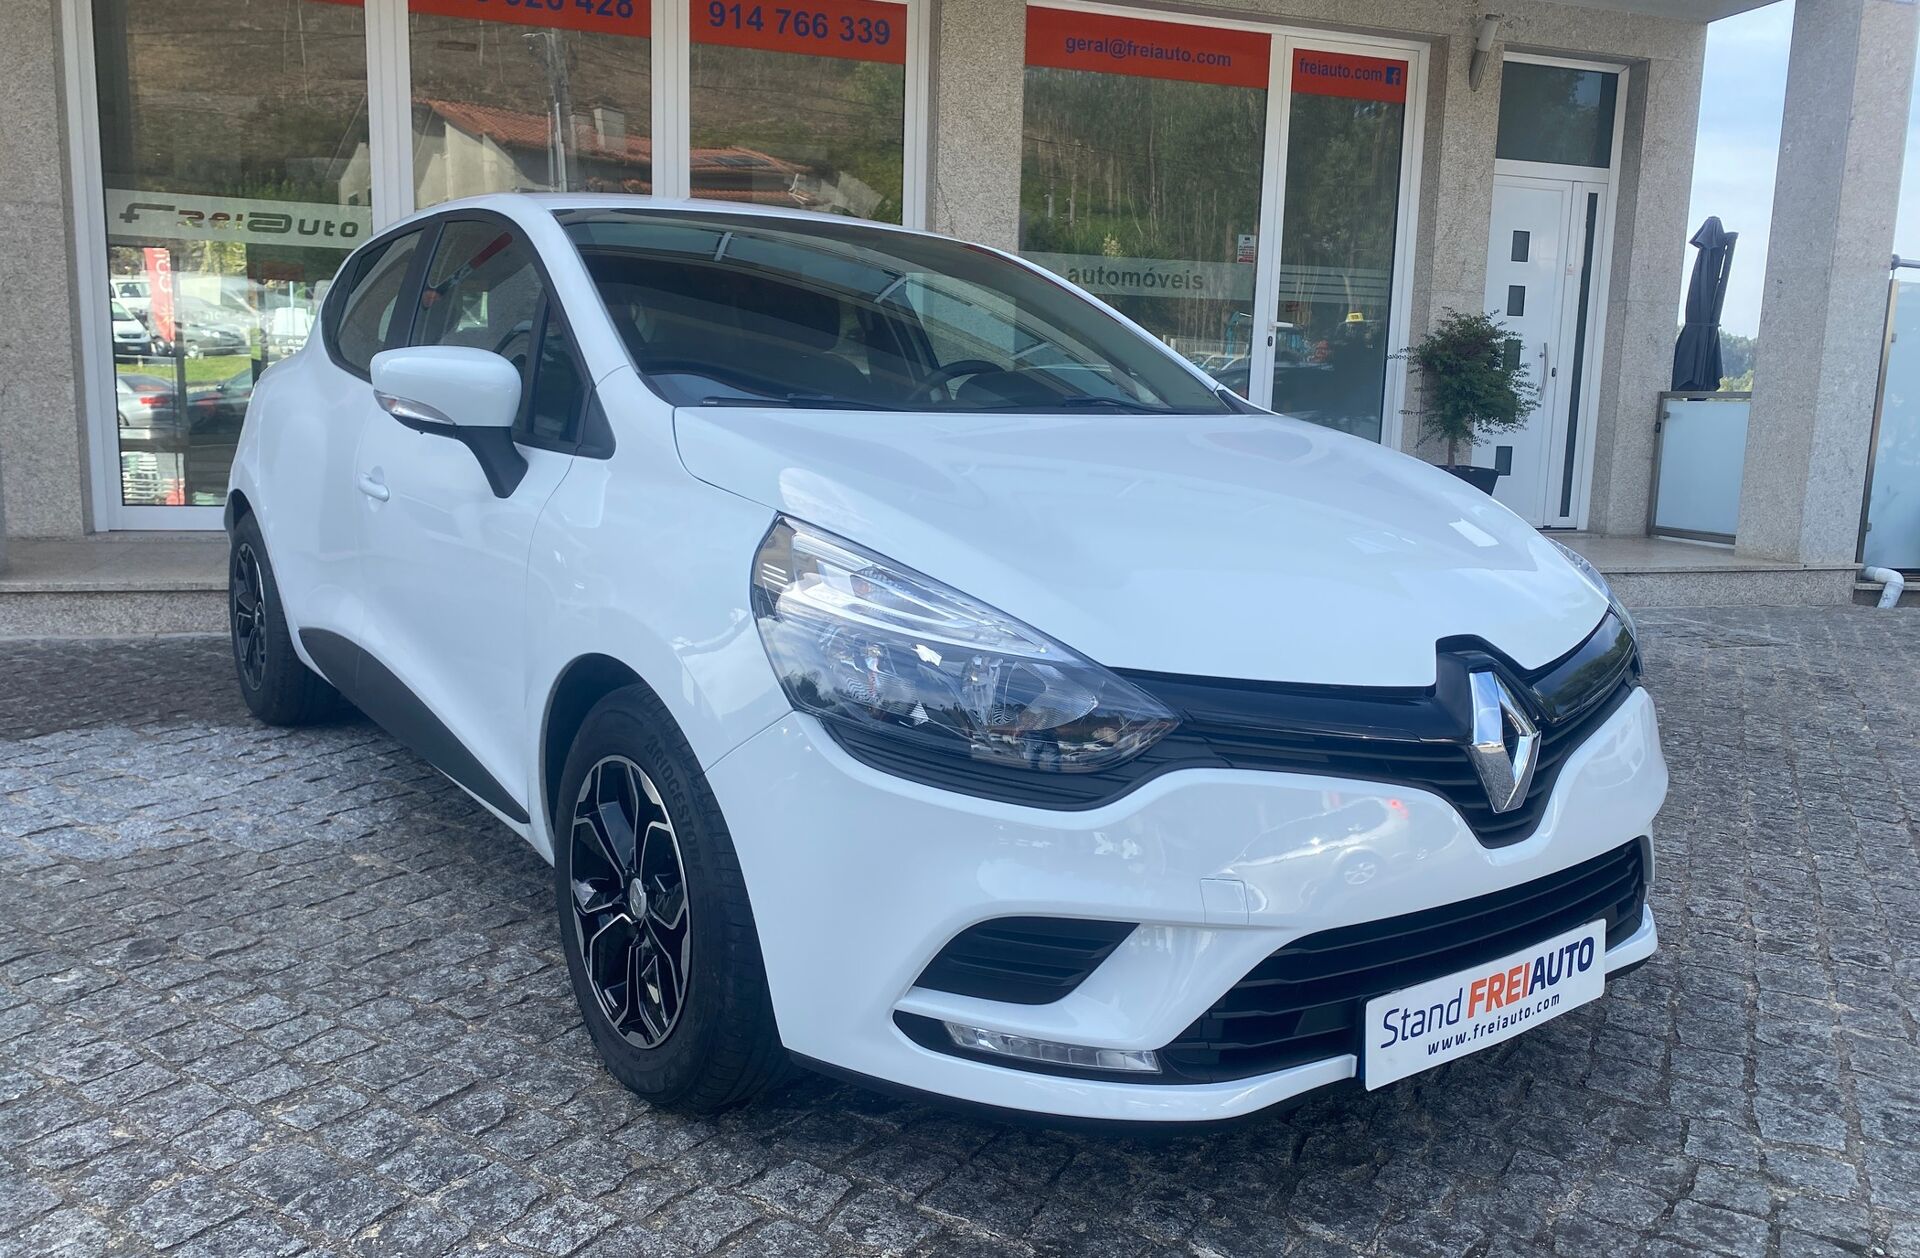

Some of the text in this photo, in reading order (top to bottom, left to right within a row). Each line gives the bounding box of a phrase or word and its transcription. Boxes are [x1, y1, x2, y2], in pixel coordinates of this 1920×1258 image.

[708, 1, 891, 45] 914 766 339
[1065, 35, 1232, 68] geral@freiauto.com
[1299, 58, 1383, 81] freiauto.com
[1067, 265, 1205, 290] automóveis
[1380, 936, 1595, 1049] Stand FREIAUTO
[1427, 993, 1560, 1056] www.freiauto.com
